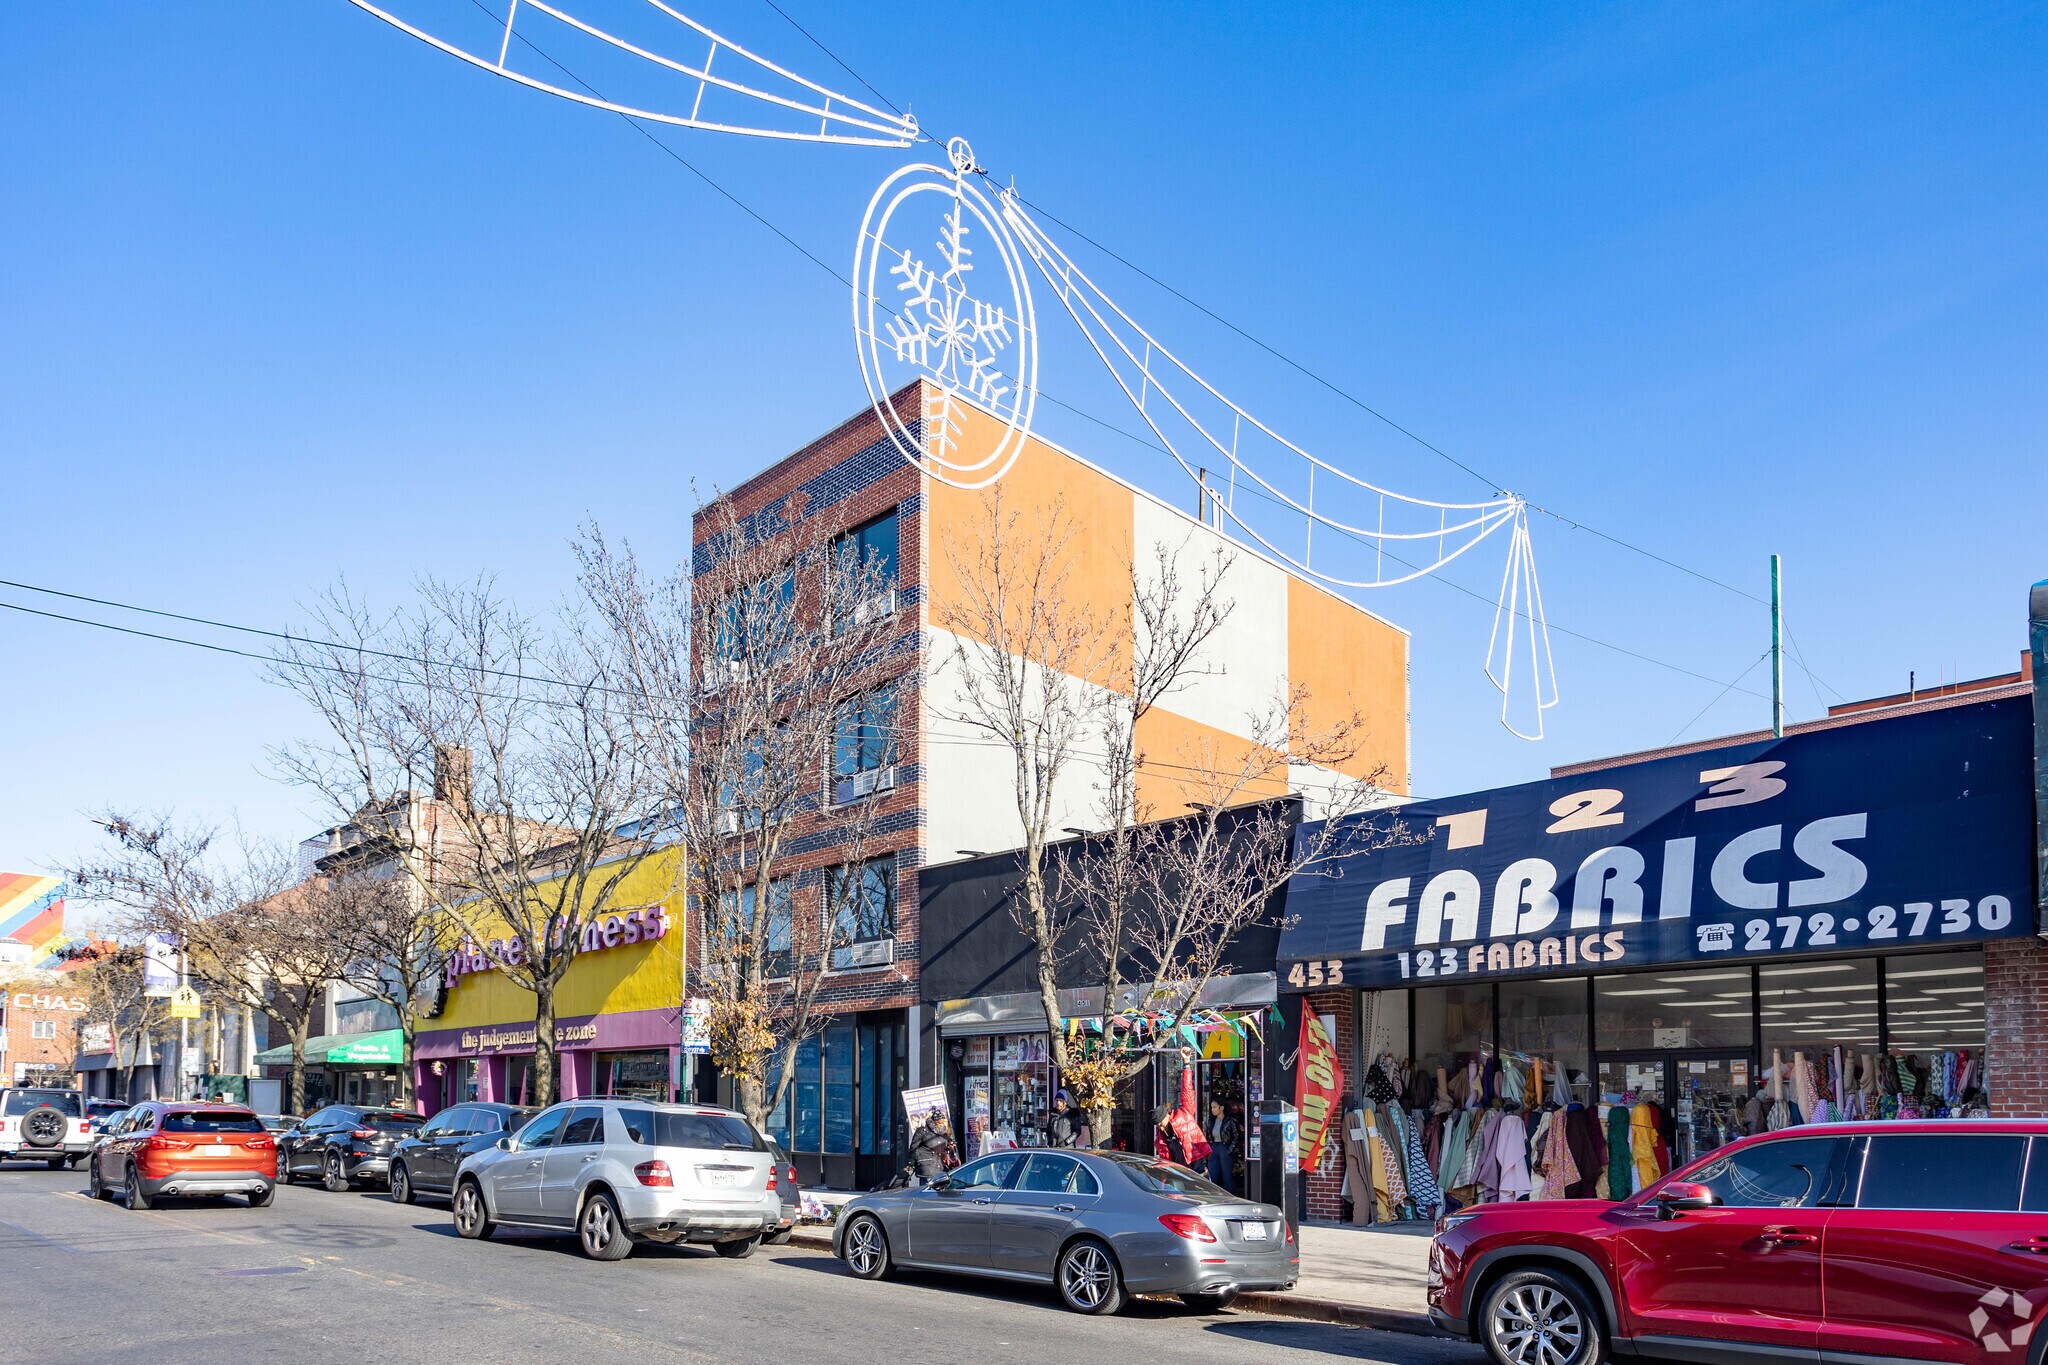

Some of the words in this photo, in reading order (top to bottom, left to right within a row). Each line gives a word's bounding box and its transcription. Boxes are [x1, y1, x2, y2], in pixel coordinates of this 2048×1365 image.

[1360, 812, 1867, 952] FABRICS
[1397, 948, 1459, 979] 123
[1468, 930, 1625, 974] FABRICS
[1287, 960, 1344, 989] 453
[13, 993, 90, 1012] CHAS
[462, 1031, 478, 1048] the
[565, 1024, 597, 1041] zone
[1287, 1124, 1295, 1140] P
